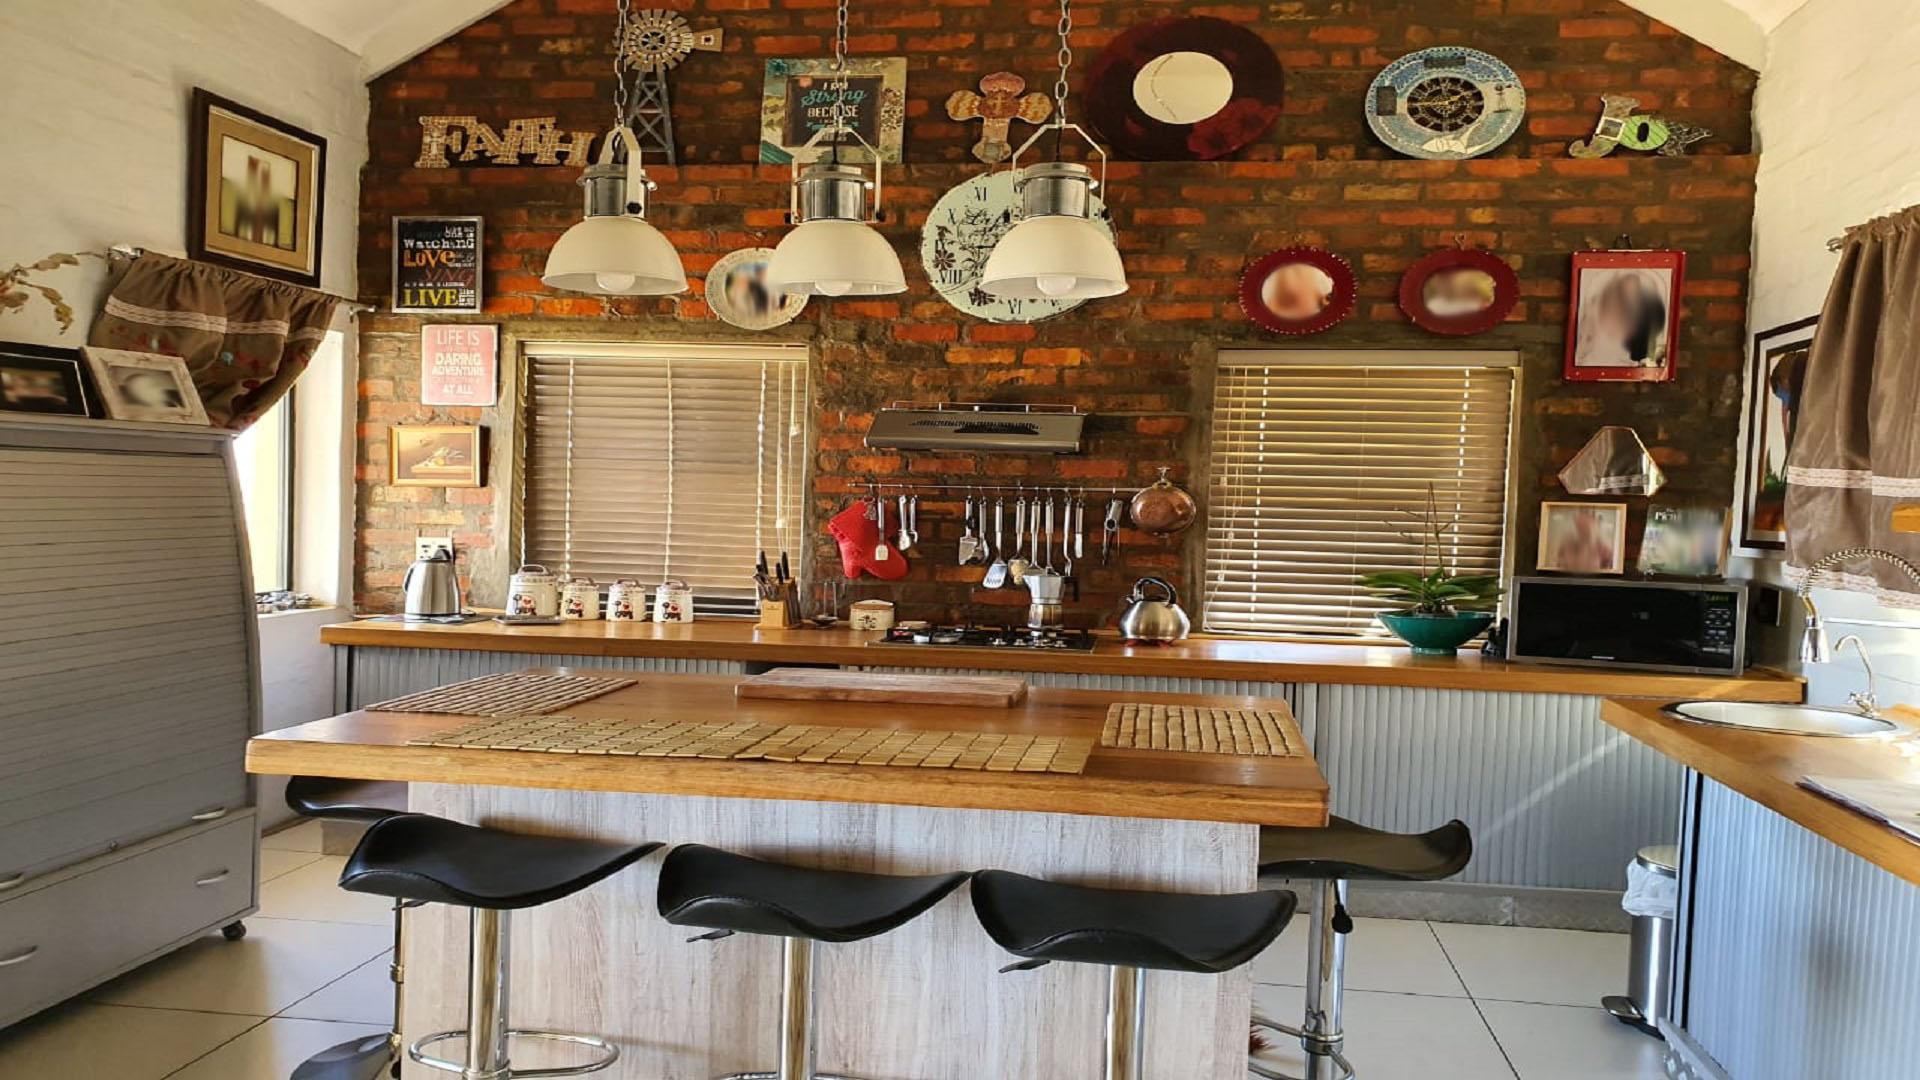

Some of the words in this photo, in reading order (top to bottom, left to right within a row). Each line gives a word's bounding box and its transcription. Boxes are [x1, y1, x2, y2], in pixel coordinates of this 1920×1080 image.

[414, 115, 597, 169] FAITH
[402, 288, 459, 306] LIVE
[437, 330, 466, 345] LIFE
[467, 330, 481, 346] IS
[436, 352, 481, 366] DARING
